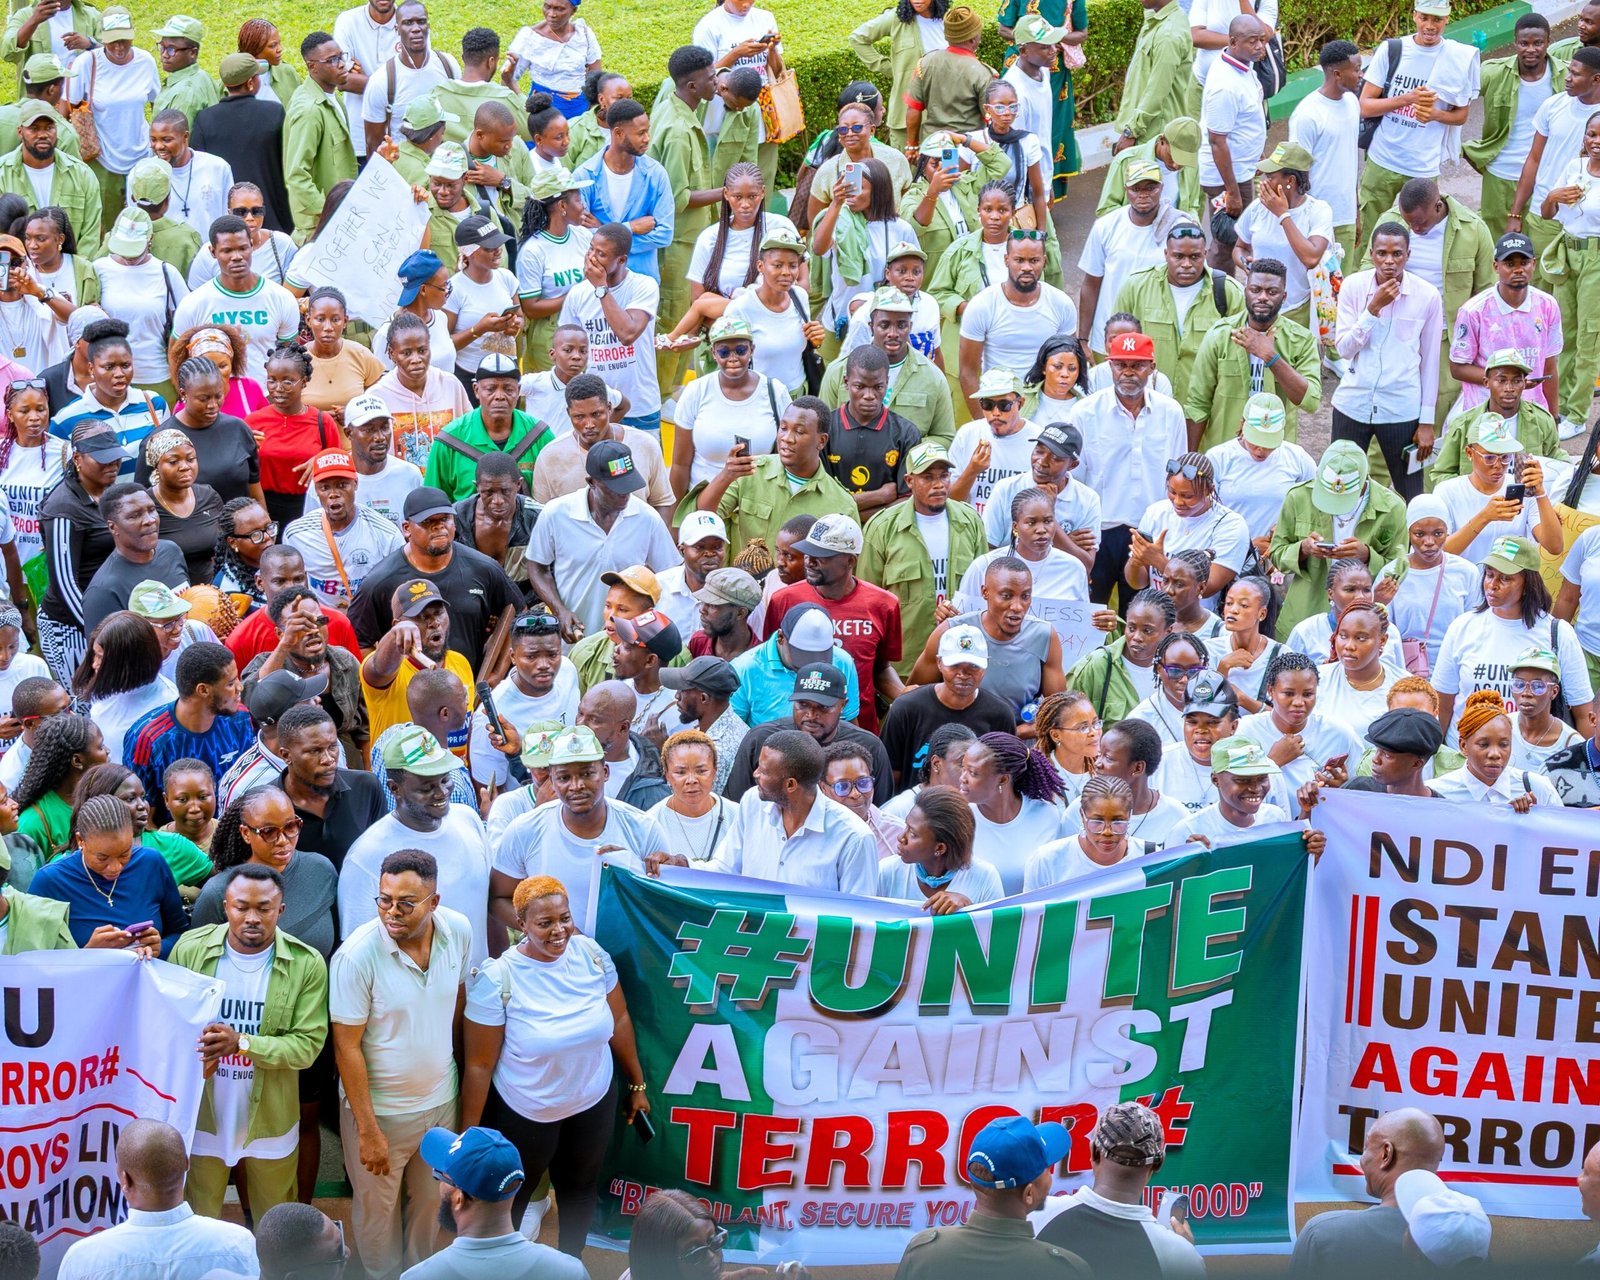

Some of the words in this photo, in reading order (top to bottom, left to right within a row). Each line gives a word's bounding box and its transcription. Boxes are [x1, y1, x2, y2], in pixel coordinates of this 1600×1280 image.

[735, 52, 769, 66] AGAINS
[304, 206, 370, 281] TOGETHER
[362, 170, 388, 200] WE
[363, 223, 390, 265] CAN
[373, 211, 406, 279] PREVENT
[553, 268, 583, 287] NYS
[211, 310, 269, 326] NYSC
[589, 332, 617, 346] AGAIN
[591, 346, 635, 362] TERROR#
[608, 361, 628, 371] ENUGU
[9, 501, 40, 516] GAINS
[19, 536, 40, 545] ENUGU
[957, 599, 1084, 623] ANESS
[833, 619, 874, 636] KETS
[1368, 831, 1509, 892] NDI
[1538, 846, 1600, 898] E
[666, 864, 1254, 1014] #UNITE
[220, 998, 265, 1021] UNIT
[662, 990, 1235, 1105] AGAINST
[233, 1070, 254, 1080] ENUG
[1338, 1104, 1600, 1169] TRRO
[800, 1200, 914, 1227] SECURE
[925, 1200, 972, 1227] YOU
